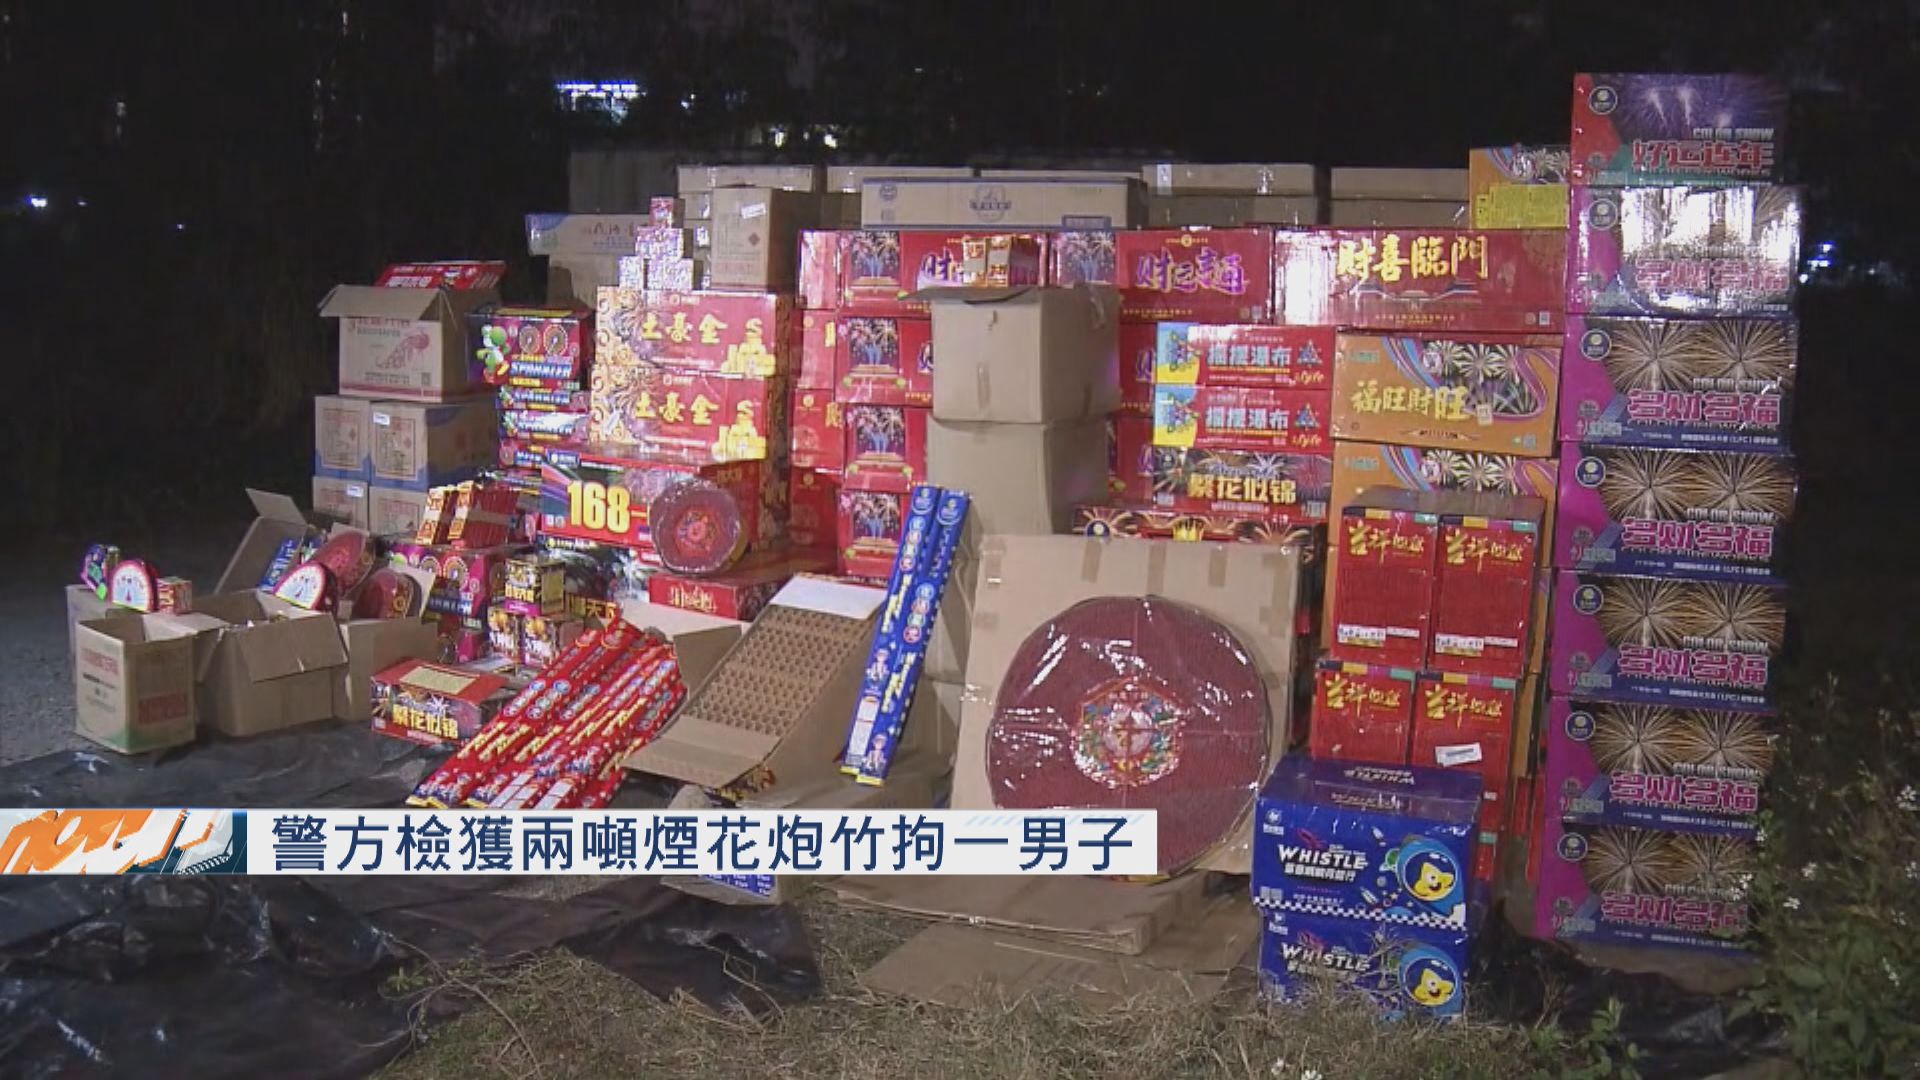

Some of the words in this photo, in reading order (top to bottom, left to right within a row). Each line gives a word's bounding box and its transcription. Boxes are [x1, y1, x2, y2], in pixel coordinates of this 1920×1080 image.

[1633, 138, 1774, 168] 好运连年
[1336, 234, 1488, 281] 財喜臨門
[641, 312, 728, 343] 土豪金
[635, 392, 720, 425] 土豪金
[1627, 388, 1781, 425] 多财多福
[1621, 517, 1774, 557] 多财多福
[1617, 643, 1769, 684] 多财多福
[1610, 770, 1758, 812] 多财多福
[1277, 844, 1369, 870] WHISTLE
[1281, 942, 1371, 971] WHISTLE
